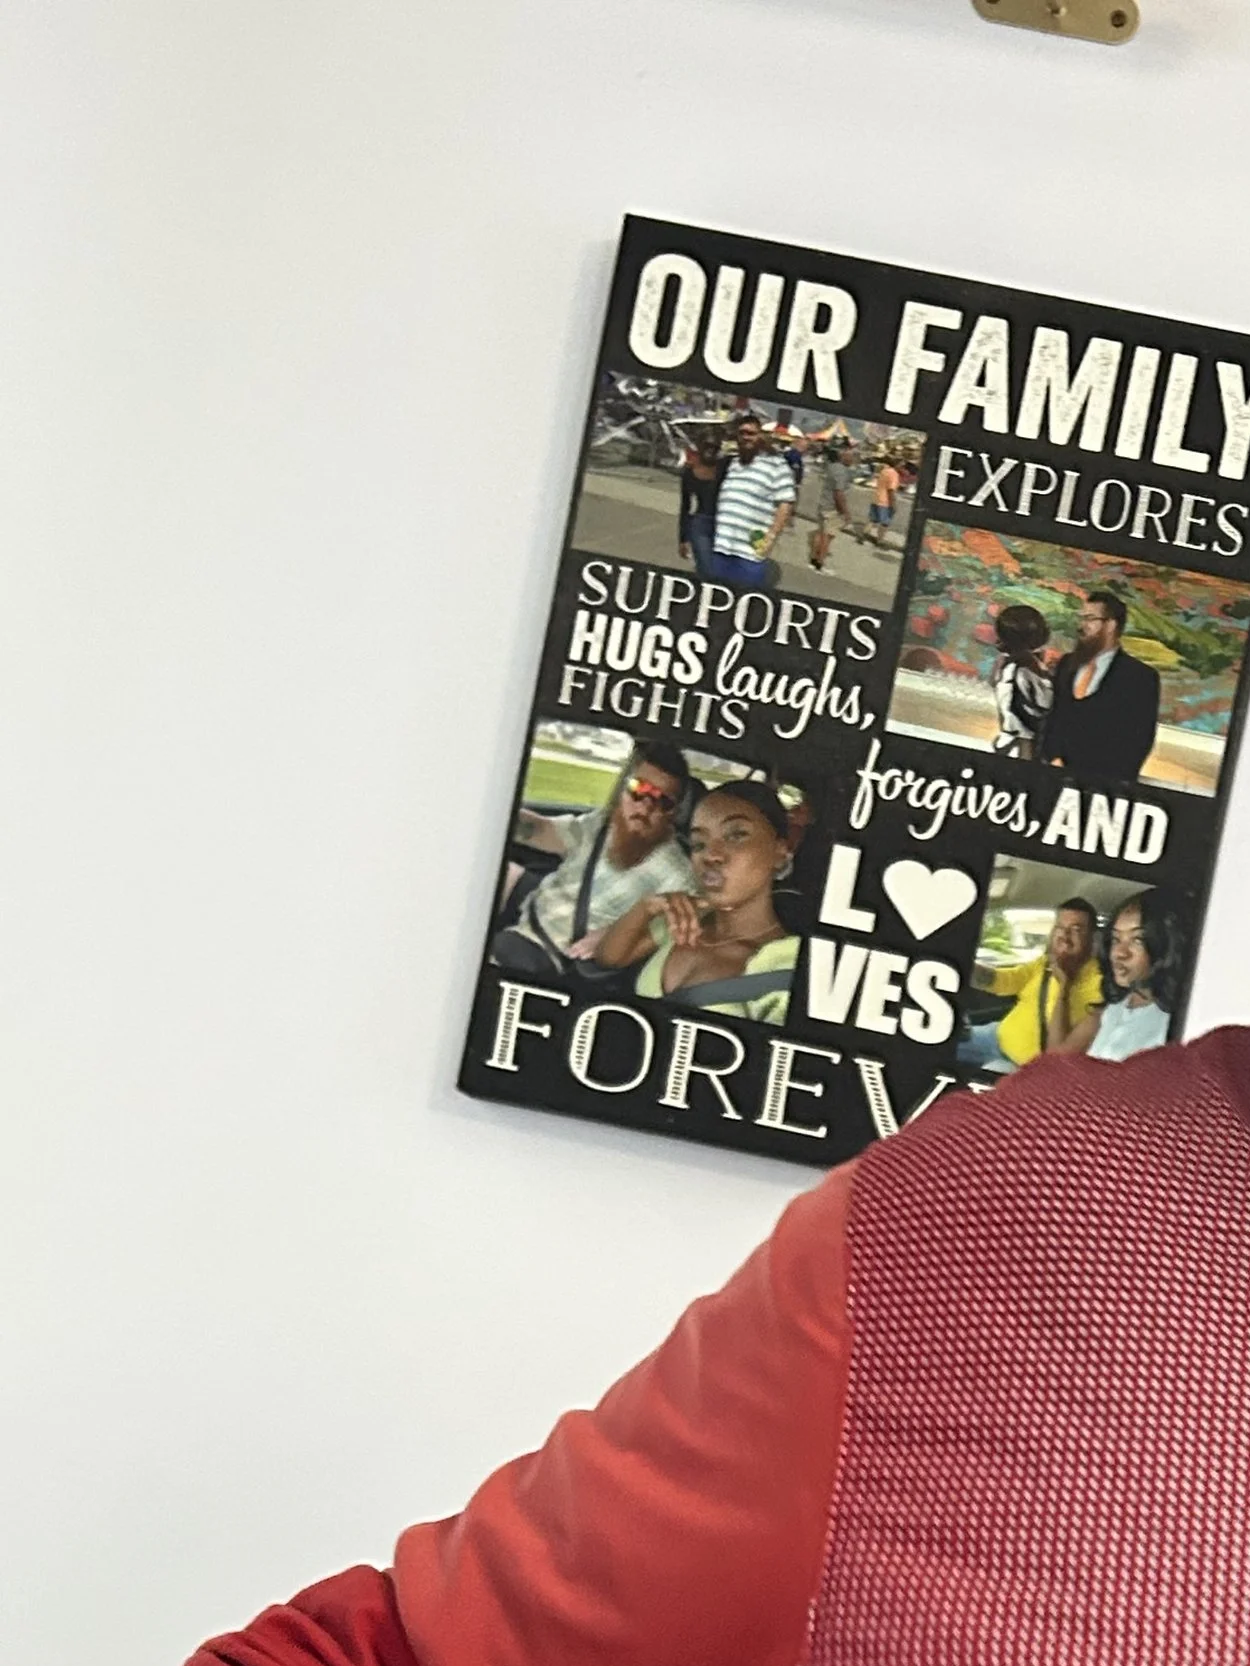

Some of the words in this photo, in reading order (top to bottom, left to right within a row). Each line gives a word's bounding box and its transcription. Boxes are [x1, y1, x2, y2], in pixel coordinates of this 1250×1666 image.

[629, 253, 857, 401] OUR
[931, 445, 1250, 556] EXPLORES
[578, 560, 881, 661] SUPPORTS
[557, 664, 750, 740] FIGHTS
[568, 609, 708, 685] HUGS
[716, 632, 876, 740] laughs,
[850, 737, 1042, 841] forgives,
[1041, 787, 1170, 865] AND
[806, 936, 960, 1044] VES
[485, 980, 997, 1140] FOREV
